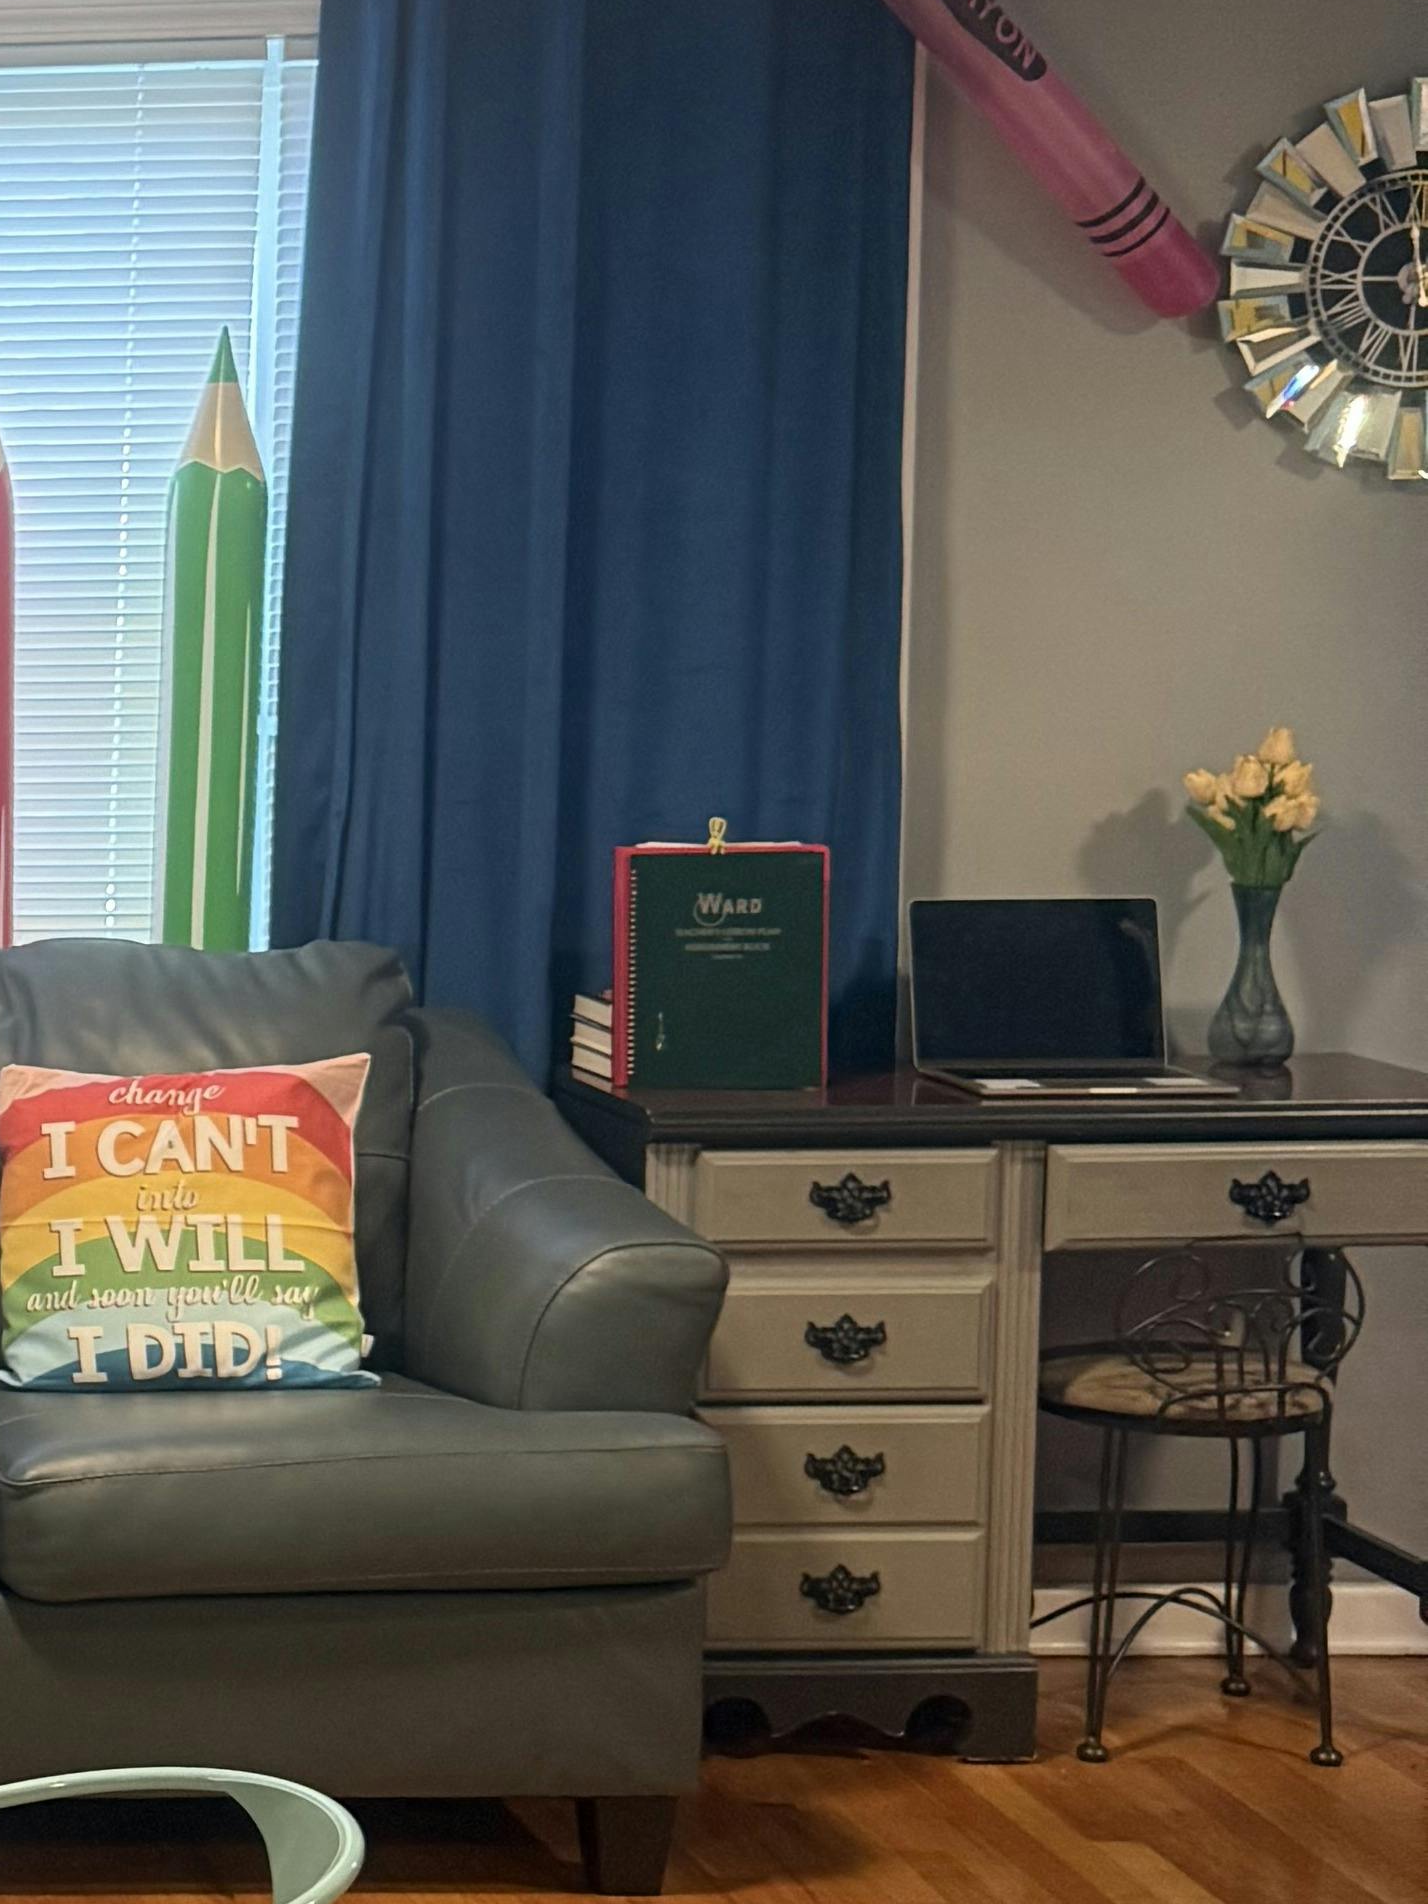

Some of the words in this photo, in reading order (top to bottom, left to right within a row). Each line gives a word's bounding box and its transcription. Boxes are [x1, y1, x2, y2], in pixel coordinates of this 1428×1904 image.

[109, 1079, 226, 1115] change
[41, 1122, 77, 1179] I
[97, 1115, 299, 1177] CAN'T
[134, 1181, 199, 1212] into
[49, 1219, 86, 1277] I
[104, 1215, 306, 1273] WILL
[26, 1280, 81, 1312] and
[87, 1283, 156, 1309] soon
[166, 1276, 261, 1322] you'll
[272, 1283, 322, 1322] say
[68, 1326, 109, 1384] I
[127, 1320, 284, 1382] DID!
